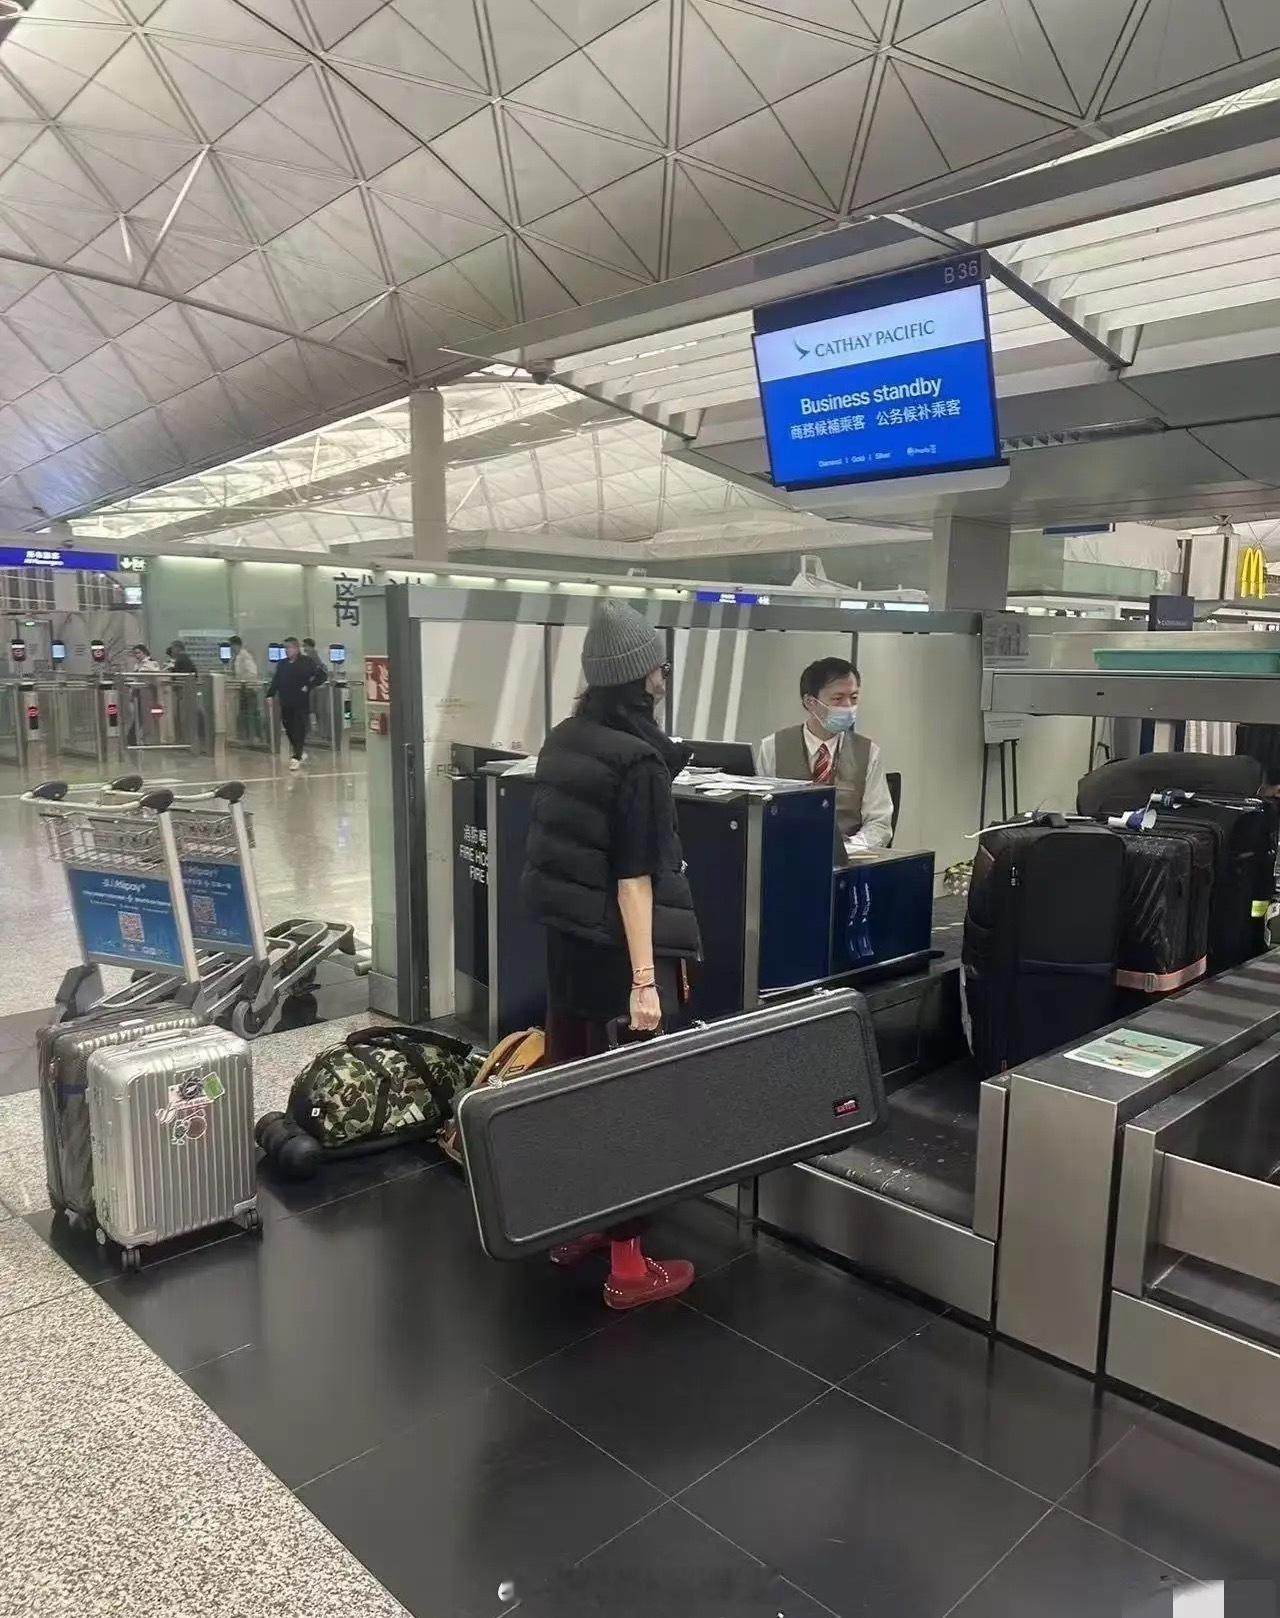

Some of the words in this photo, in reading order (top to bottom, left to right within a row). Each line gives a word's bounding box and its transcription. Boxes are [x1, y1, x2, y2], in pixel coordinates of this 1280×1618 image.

[815, 332, 873, 357] CATHAY
[875, 320, 935, 345] PACIFIC
[801, 391, 870, 415] Business
[873, 377, 942, 403] standby
[876, 399, 961, 426] 公务候补乘客
